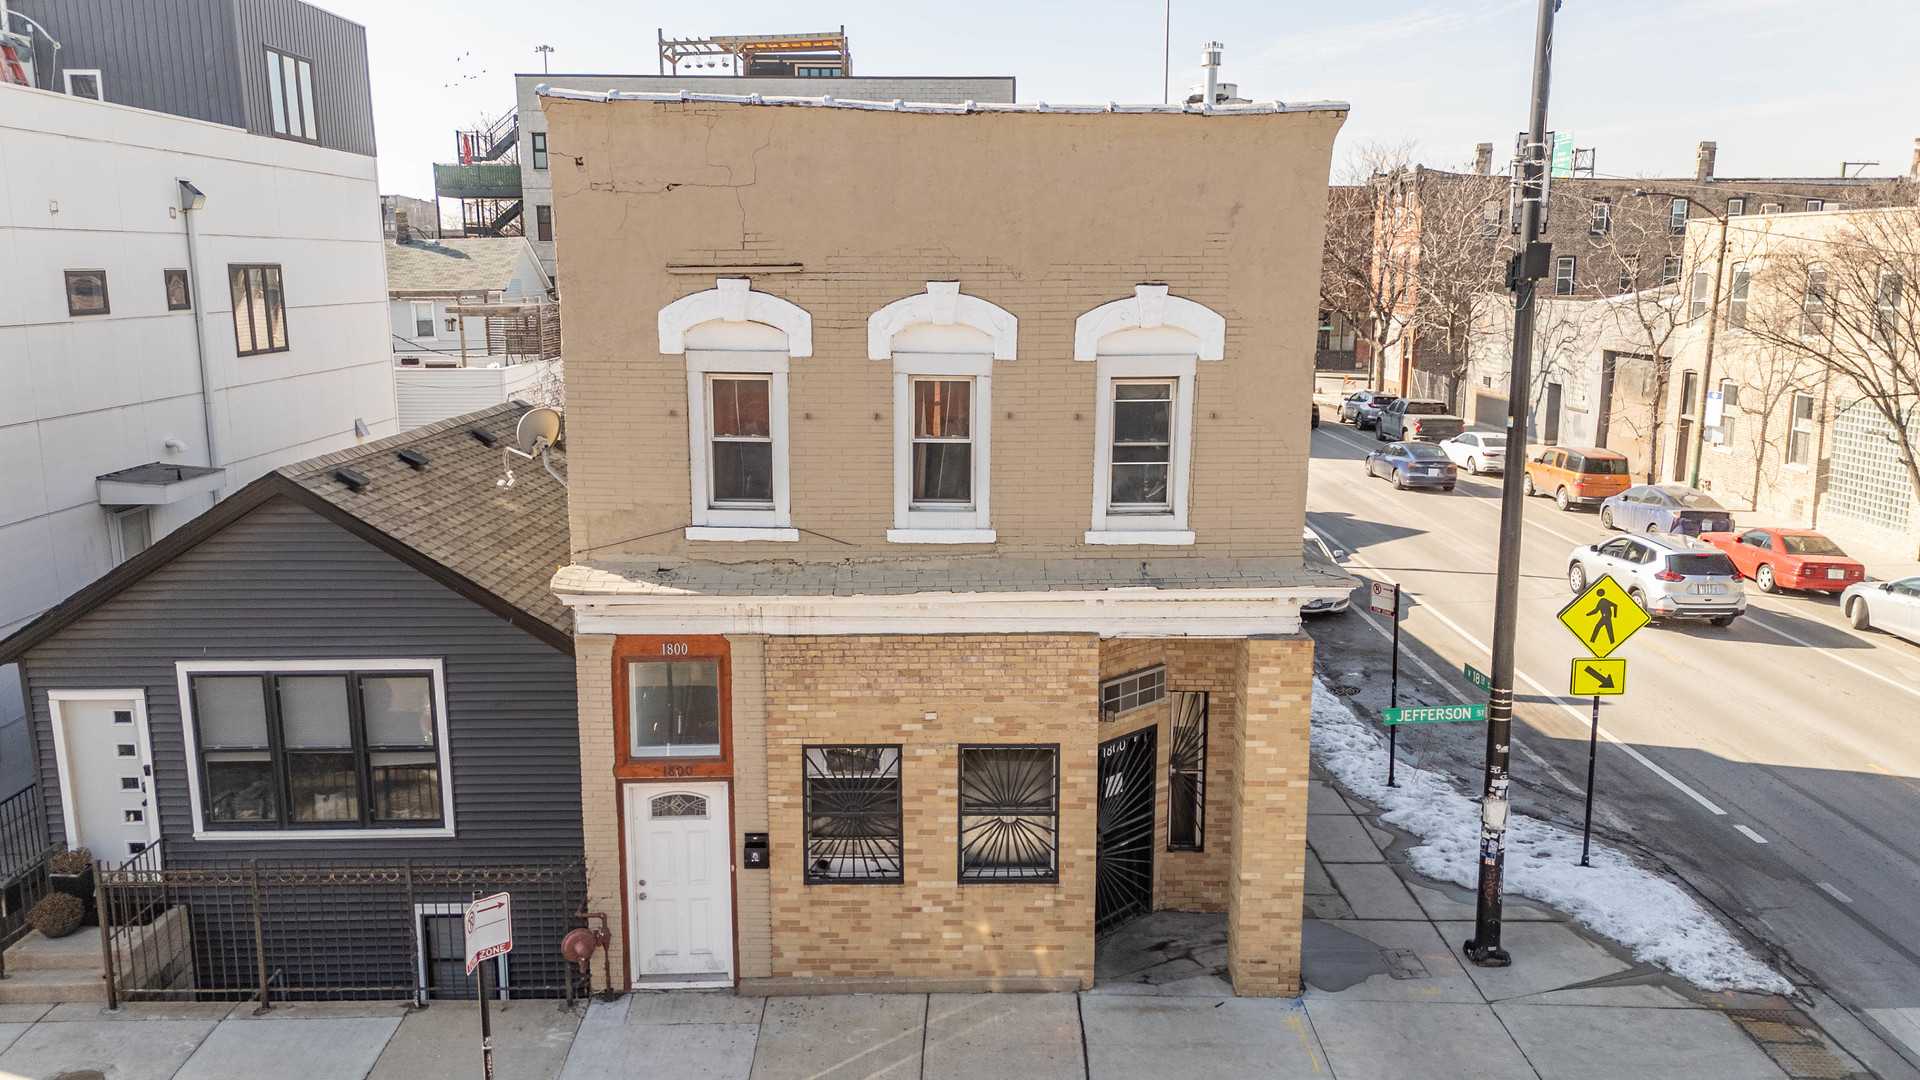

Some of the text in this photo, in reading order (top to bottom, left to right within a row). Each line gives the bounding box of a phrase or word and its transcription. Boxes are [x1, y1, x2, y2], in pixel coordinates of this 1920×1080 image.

[662, 643, 688, 656] 1800
[1397, 707, 1472, 722] JEFFERSON
[480, 944, 506, 959] ZONE
